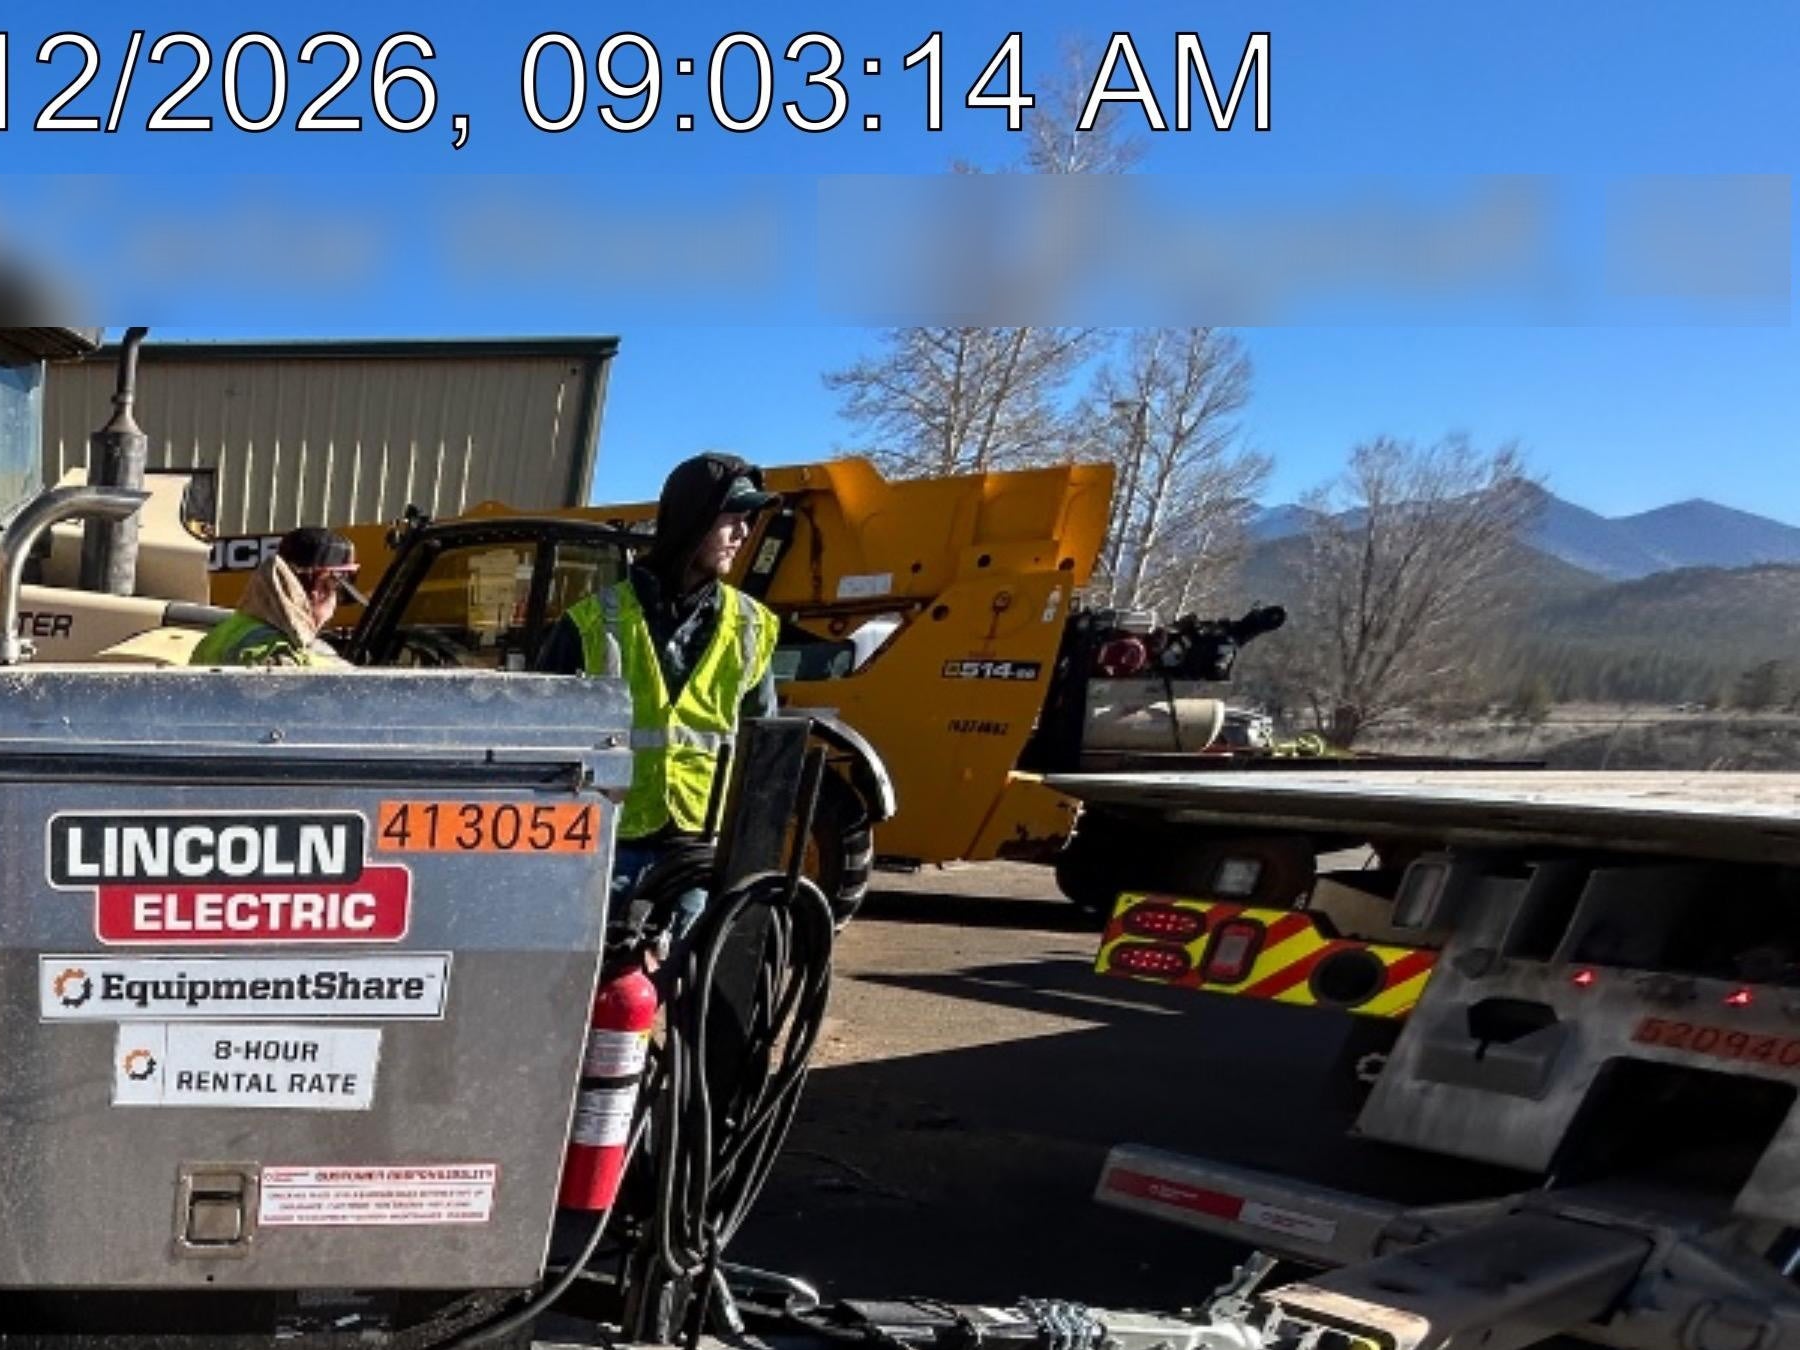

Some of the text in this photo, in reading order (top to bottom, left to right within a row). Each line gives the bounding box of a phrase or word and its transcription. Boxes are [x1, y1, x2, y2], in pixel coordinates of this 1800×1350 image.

[381, 803, 593, 850] 413054
[67, 826, 346, 877] LINCOLN
[133, 892, 377, 932] ELECTRIC
[101, 972, 425, 1008] EquipmentShare
[214, 1040, 319, 1063] 8-HOUR
[176, 1070, 358, 1095] RENTAL RATE
